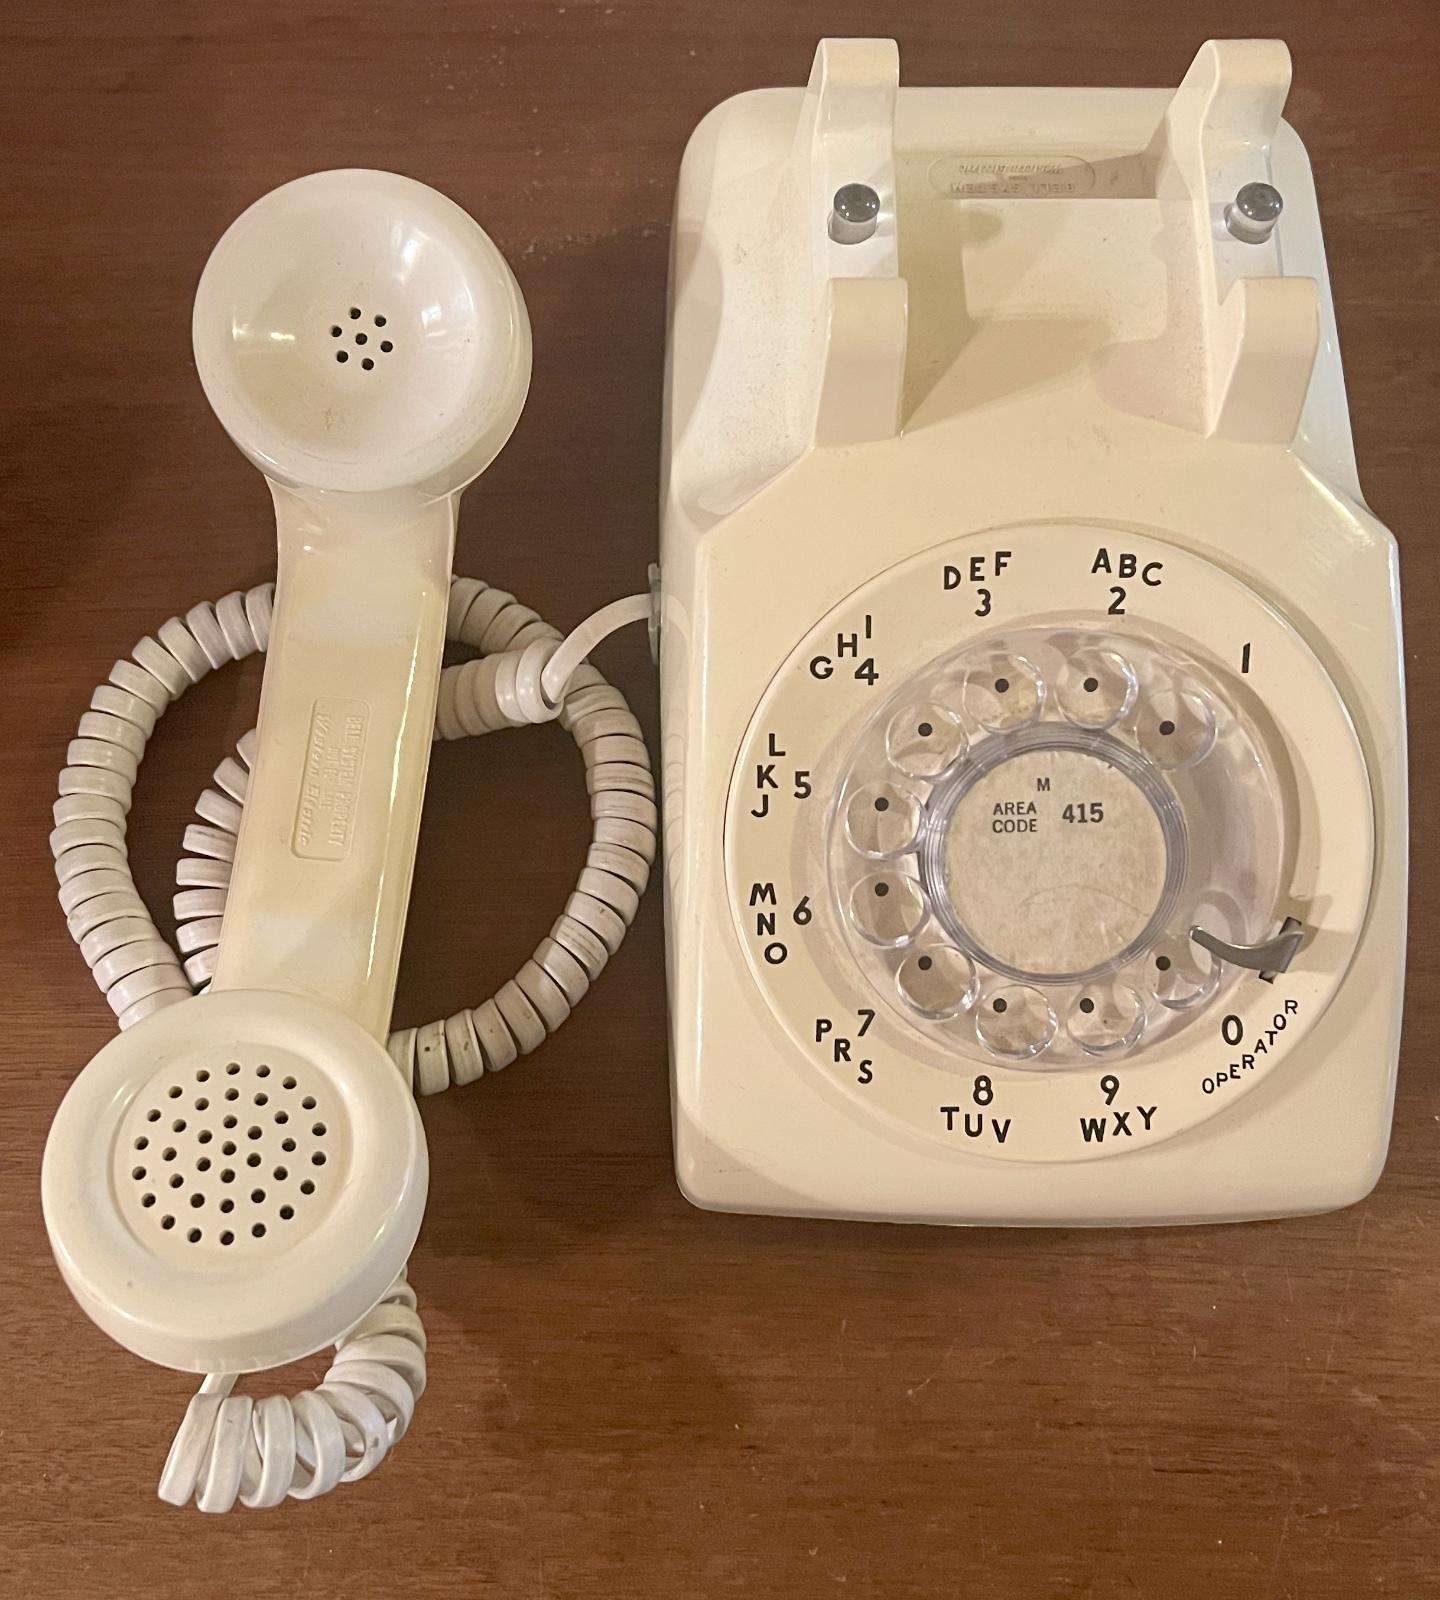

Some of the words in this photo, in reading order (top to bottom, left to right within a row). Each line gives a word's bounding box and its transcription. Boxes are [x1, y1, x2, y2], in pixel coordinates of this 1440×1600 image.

[949, 183, 1024, 194] SYSTEM
[943, 551, 1012, 591] DEF
[1091, 547, 1164, 587] ABC
[975, 589, 992, 616] 3
[1108, 587, 1127, 615] 2
[854, 658, 880, 686] 4
[308, 712, 332, 776] Western
[793, 771, 812, 799] 5
[1036, 778, 1051, 792] M
[992, 801, 1038, 816] AREA
[1061, 802, 1104, 824] 415
[992, 818, 1038, 834] CODE
[793, 896, 813, 925] 6
[857, 1010, 876, 1037] 7
[1201, 999, 1298, 1095] OPERATOR
[972, 1075, 994, 1106] 8
[1100, 1075, 1120, 1106] 9
[939, 1106, 1012, 1144] TUV
[1079, 1105, 1158, 1143] WXY
